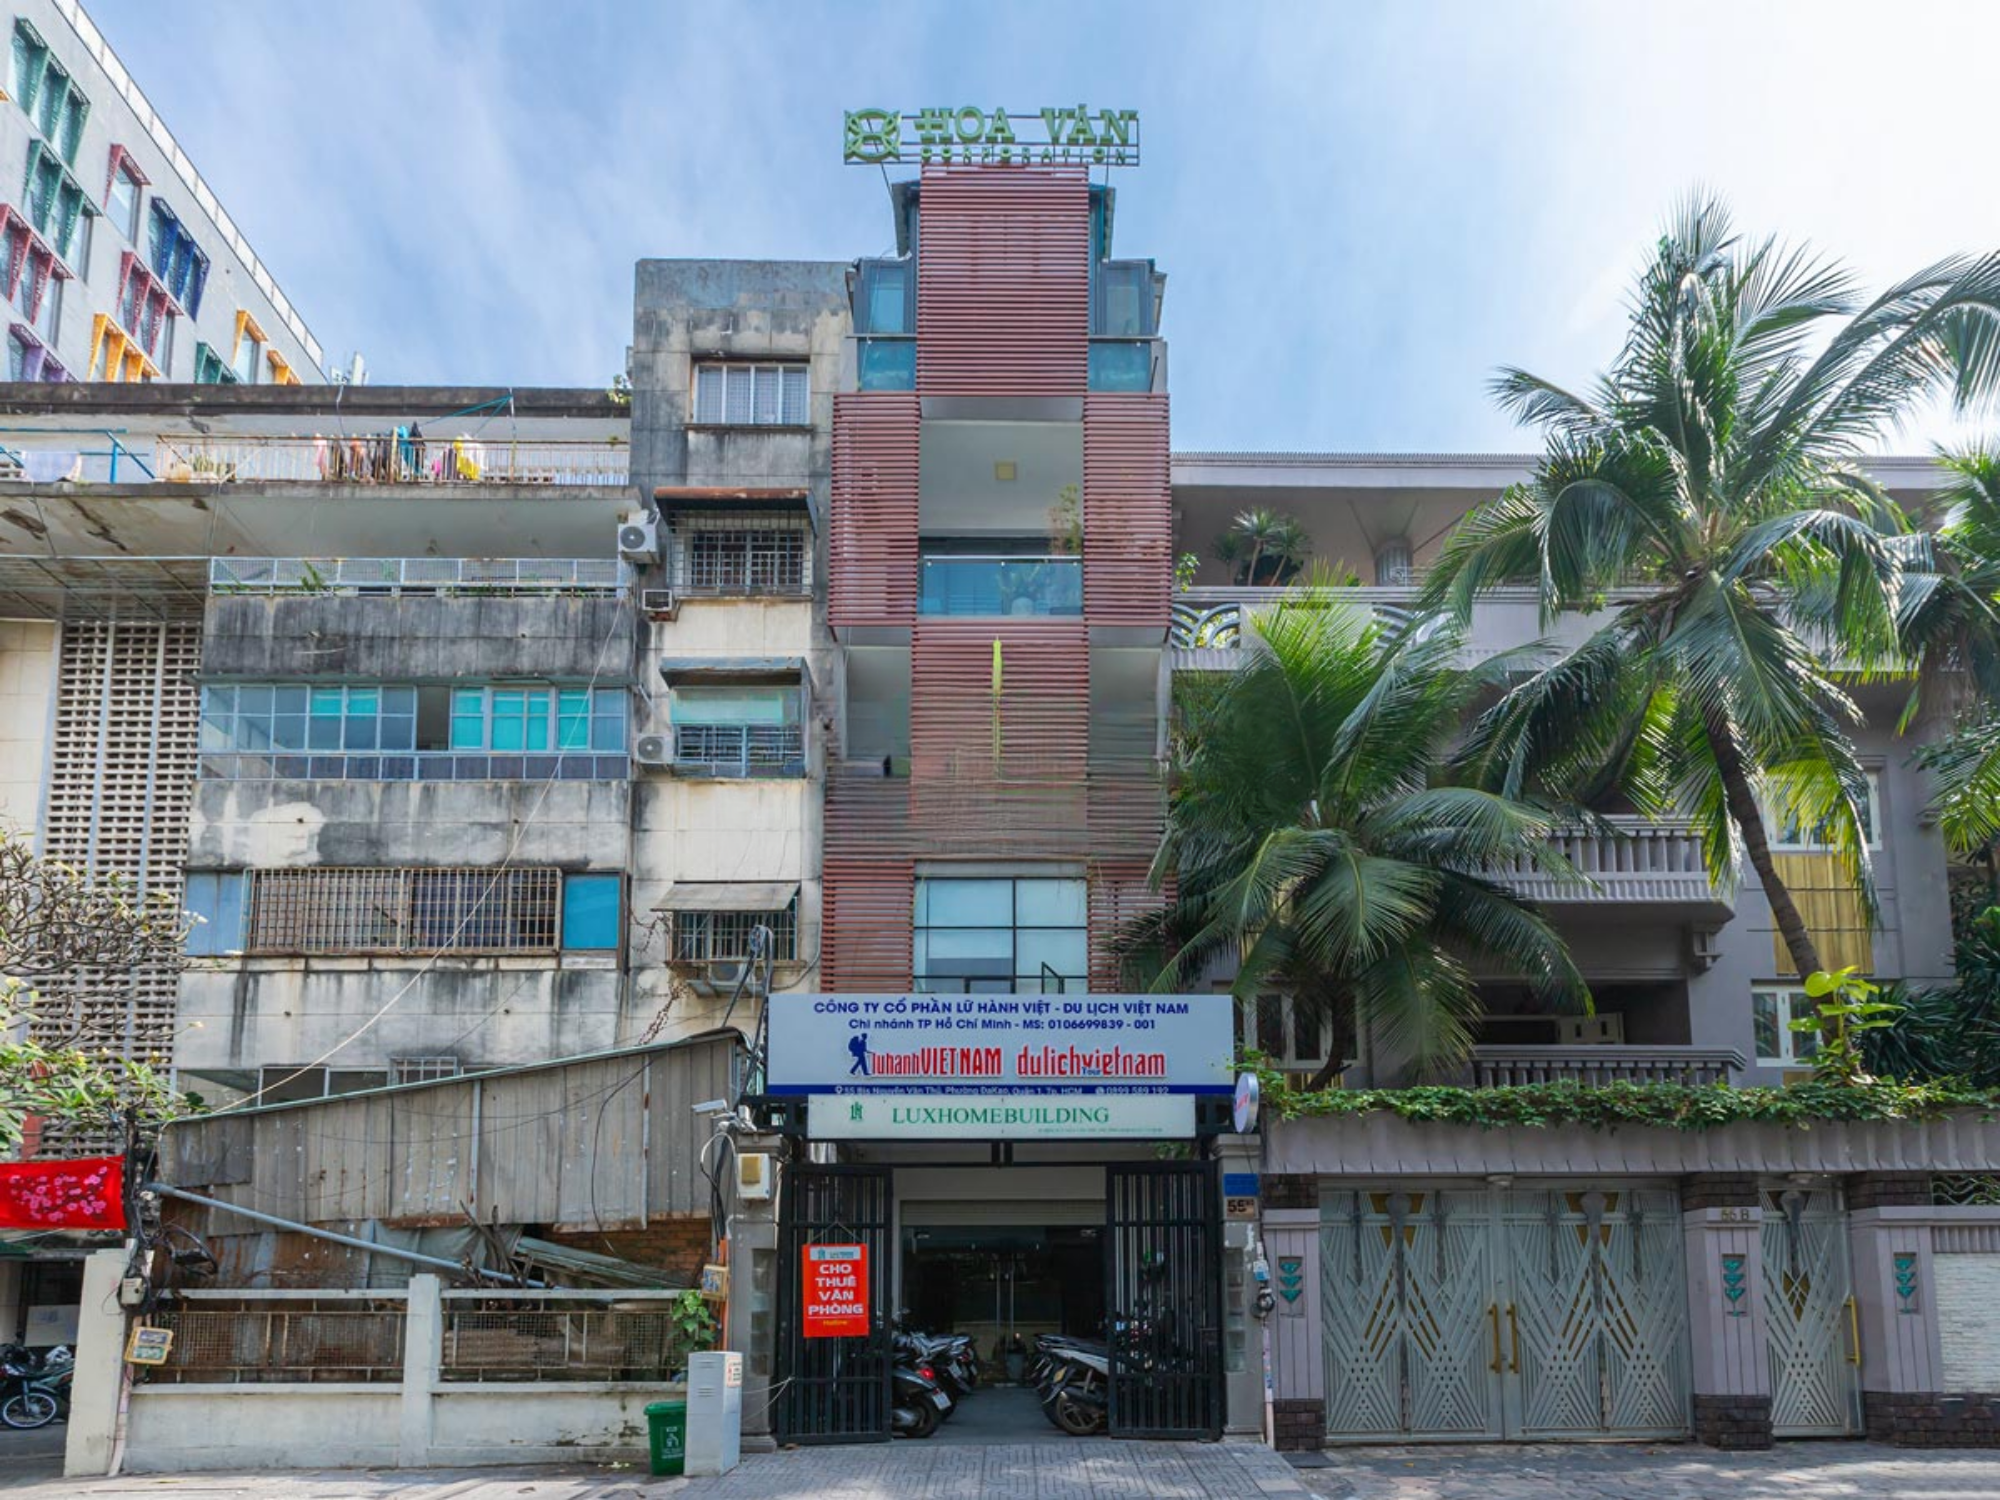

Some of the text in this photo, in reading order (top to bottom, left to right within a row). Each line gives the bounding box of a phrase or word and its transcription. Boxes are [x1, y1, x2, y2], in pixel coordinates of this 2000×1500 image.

[913, 106, 1016, 144] HOA
[921, 146, 1126, 165] CORPORATION
[813, 999, 859, 1013] CÔNG
[863, 1002, 879, 1013] TY
[883, 996, 907, 1013] CỔ
[911, 997, 952, 1013] PHẦN
[978, 998, 1019, 1014] HÀNH
[1023, 999, 1051, 1016] VIỆT
[1063, 1002, 1082, 1014] DU
[1087, 1002, 1119, 1016] LỊCH
[1123, 999, 1152, 1016] VIỆT
[1156, 1002, 1189, 1014] NAM
[849, 1018, 871, 1029] Chi
[874, 1018, 914, 1029] nhánh
[917, 1019, 932, 1029] TP
[956, 1018, 978, 1029] Chí
[981, 1019, 1012, 1029] Minh
[1023, 1019, 1044, 1029] MS:
[1134, 1019, 1155, 1029] 001
[1017, 1044, 1165, 1075] dulichvietnam
[892, 1107, 1110, 1124] LUXHOMEBUILDING
[819, 1263, 852, 1274] CHO
[815, 1275, 857, 1287] THUÊ
[808, 1302, 864, 1315] PHÒNG
